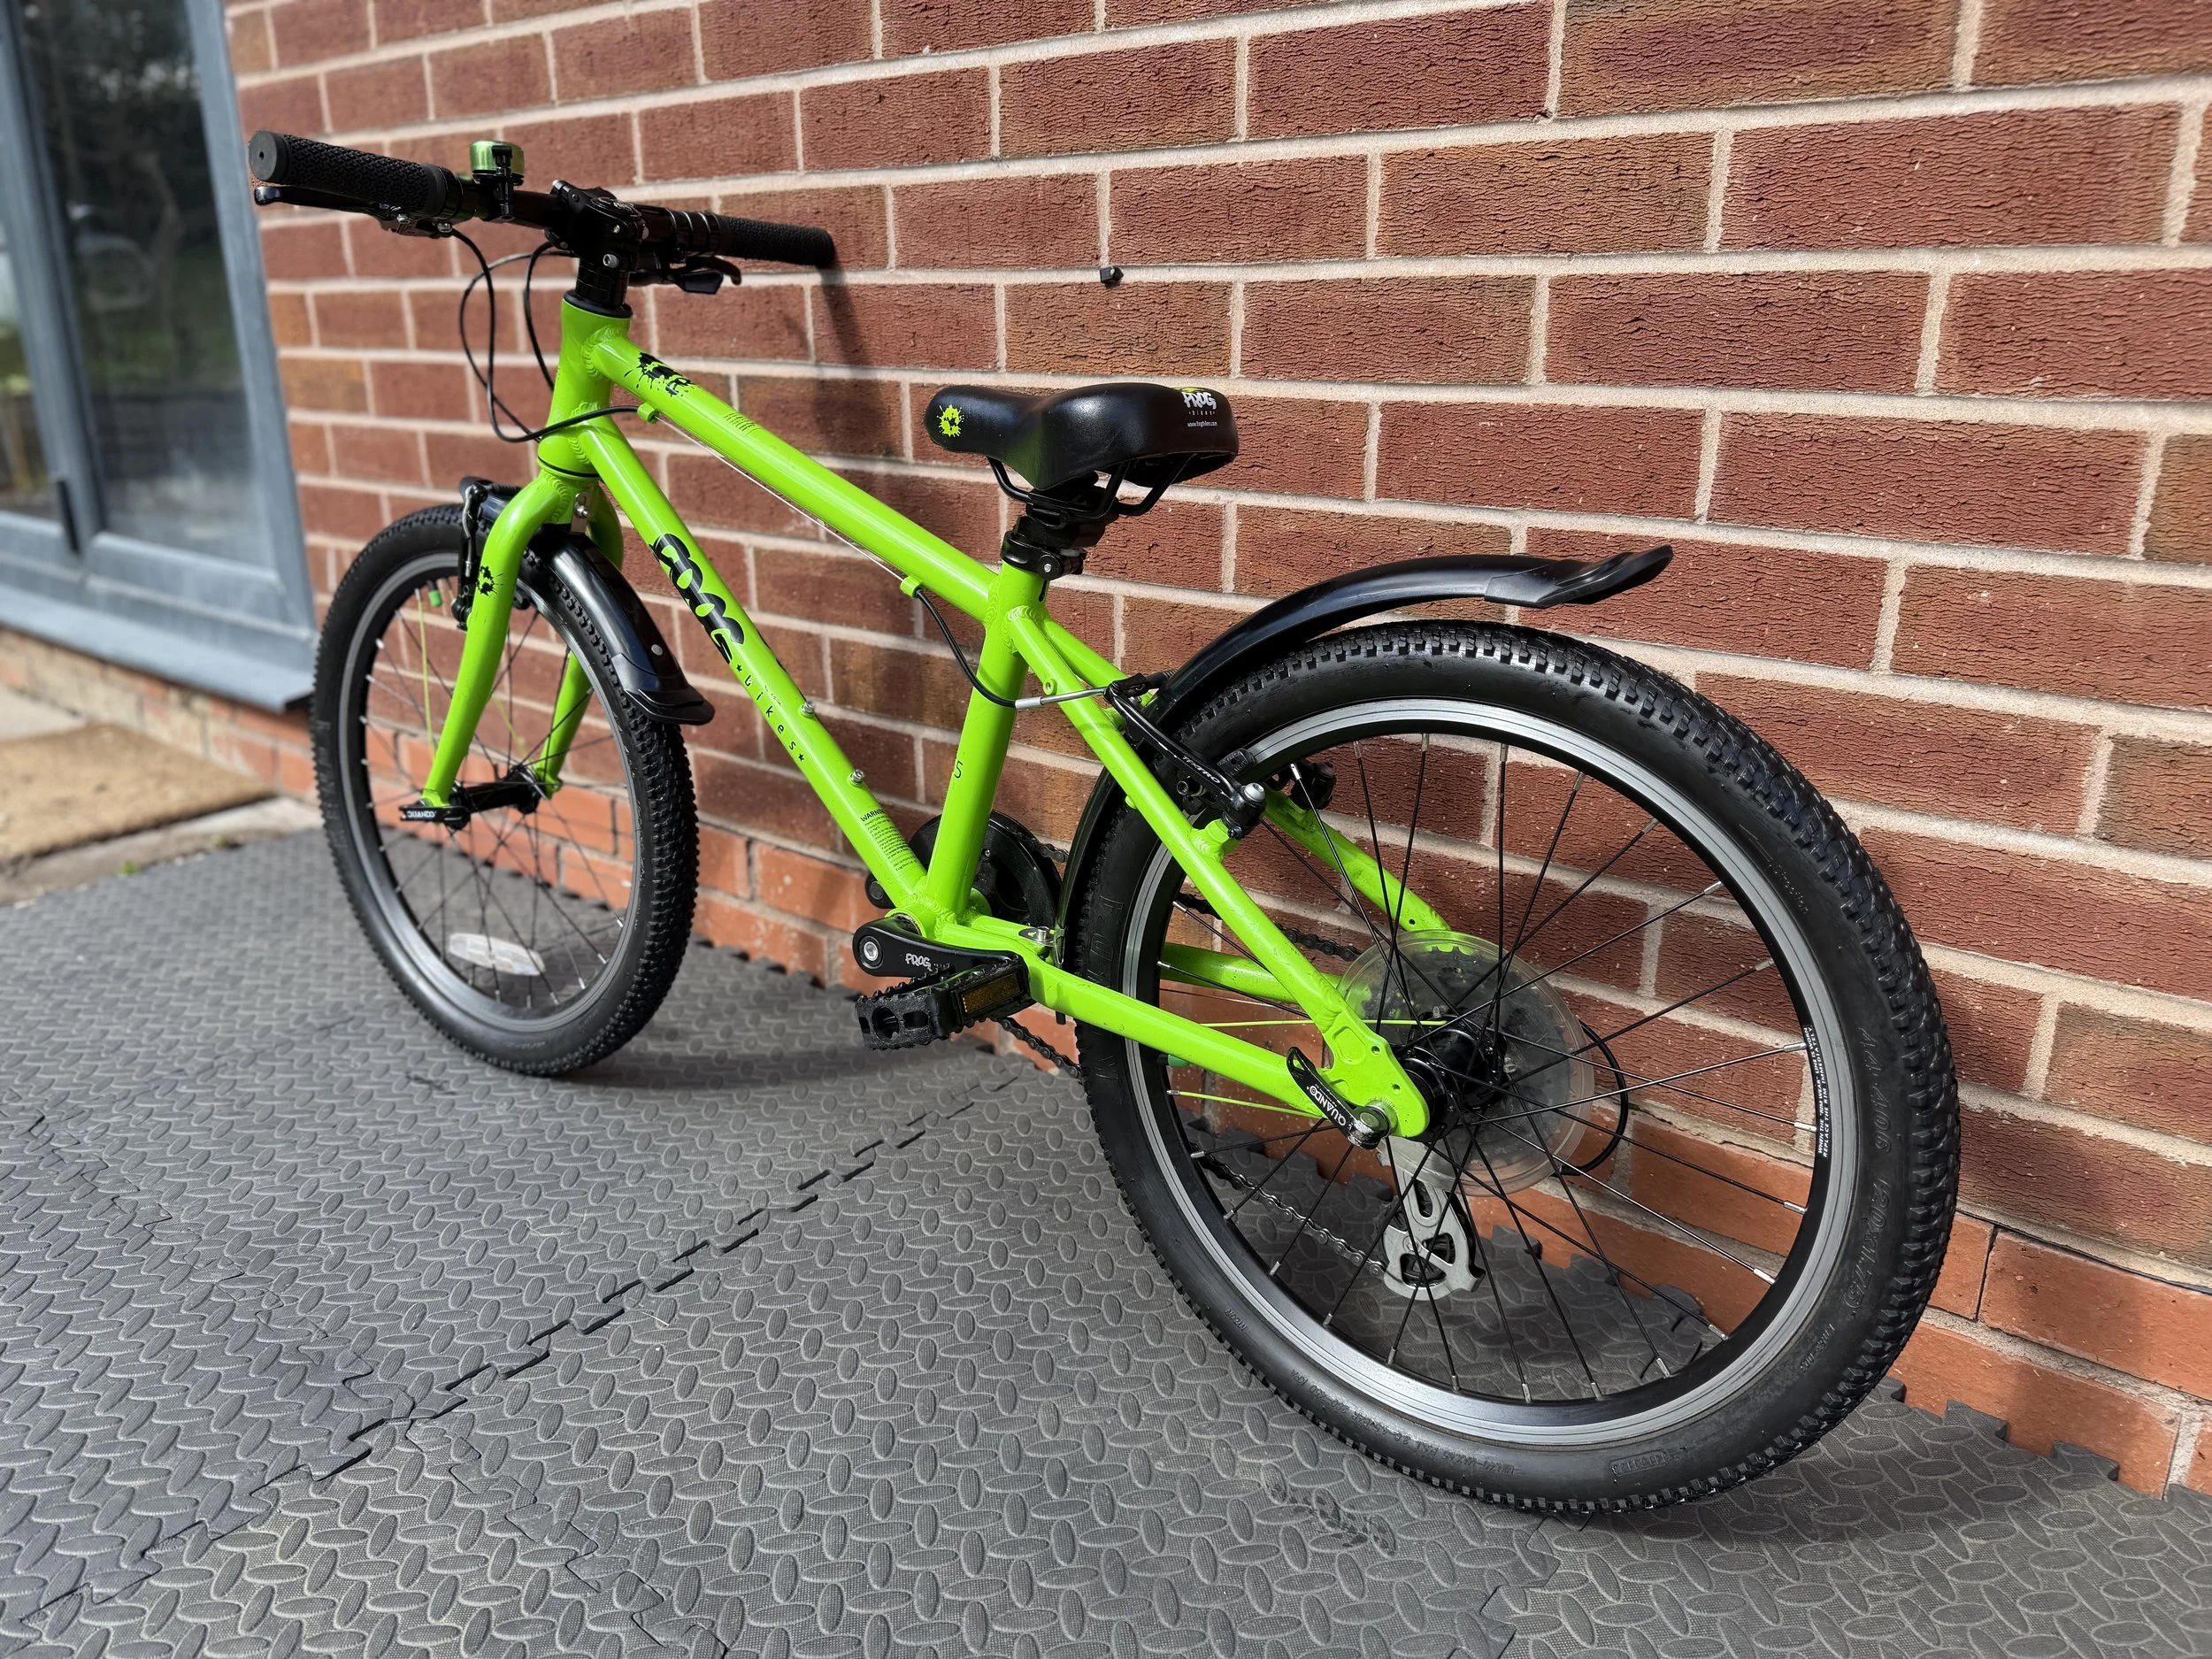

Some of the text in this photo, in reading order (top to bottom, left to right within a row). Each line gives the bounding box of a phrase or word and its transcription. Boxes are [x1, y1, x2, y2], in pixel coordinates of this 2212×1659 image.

[1181, 391, 1217, 410] FROG
[744, 674, 796, 750] bikes
[1182, 755, 1220, 784] TEKTRO
[904, 952, 933, 972] FROG
[1803, 1027, 1814, 1050] WORN
[1808, 1026, 1826, 1084] IMMEDIATELY
[1310, 1085, 1347, 1126] QUANDO
